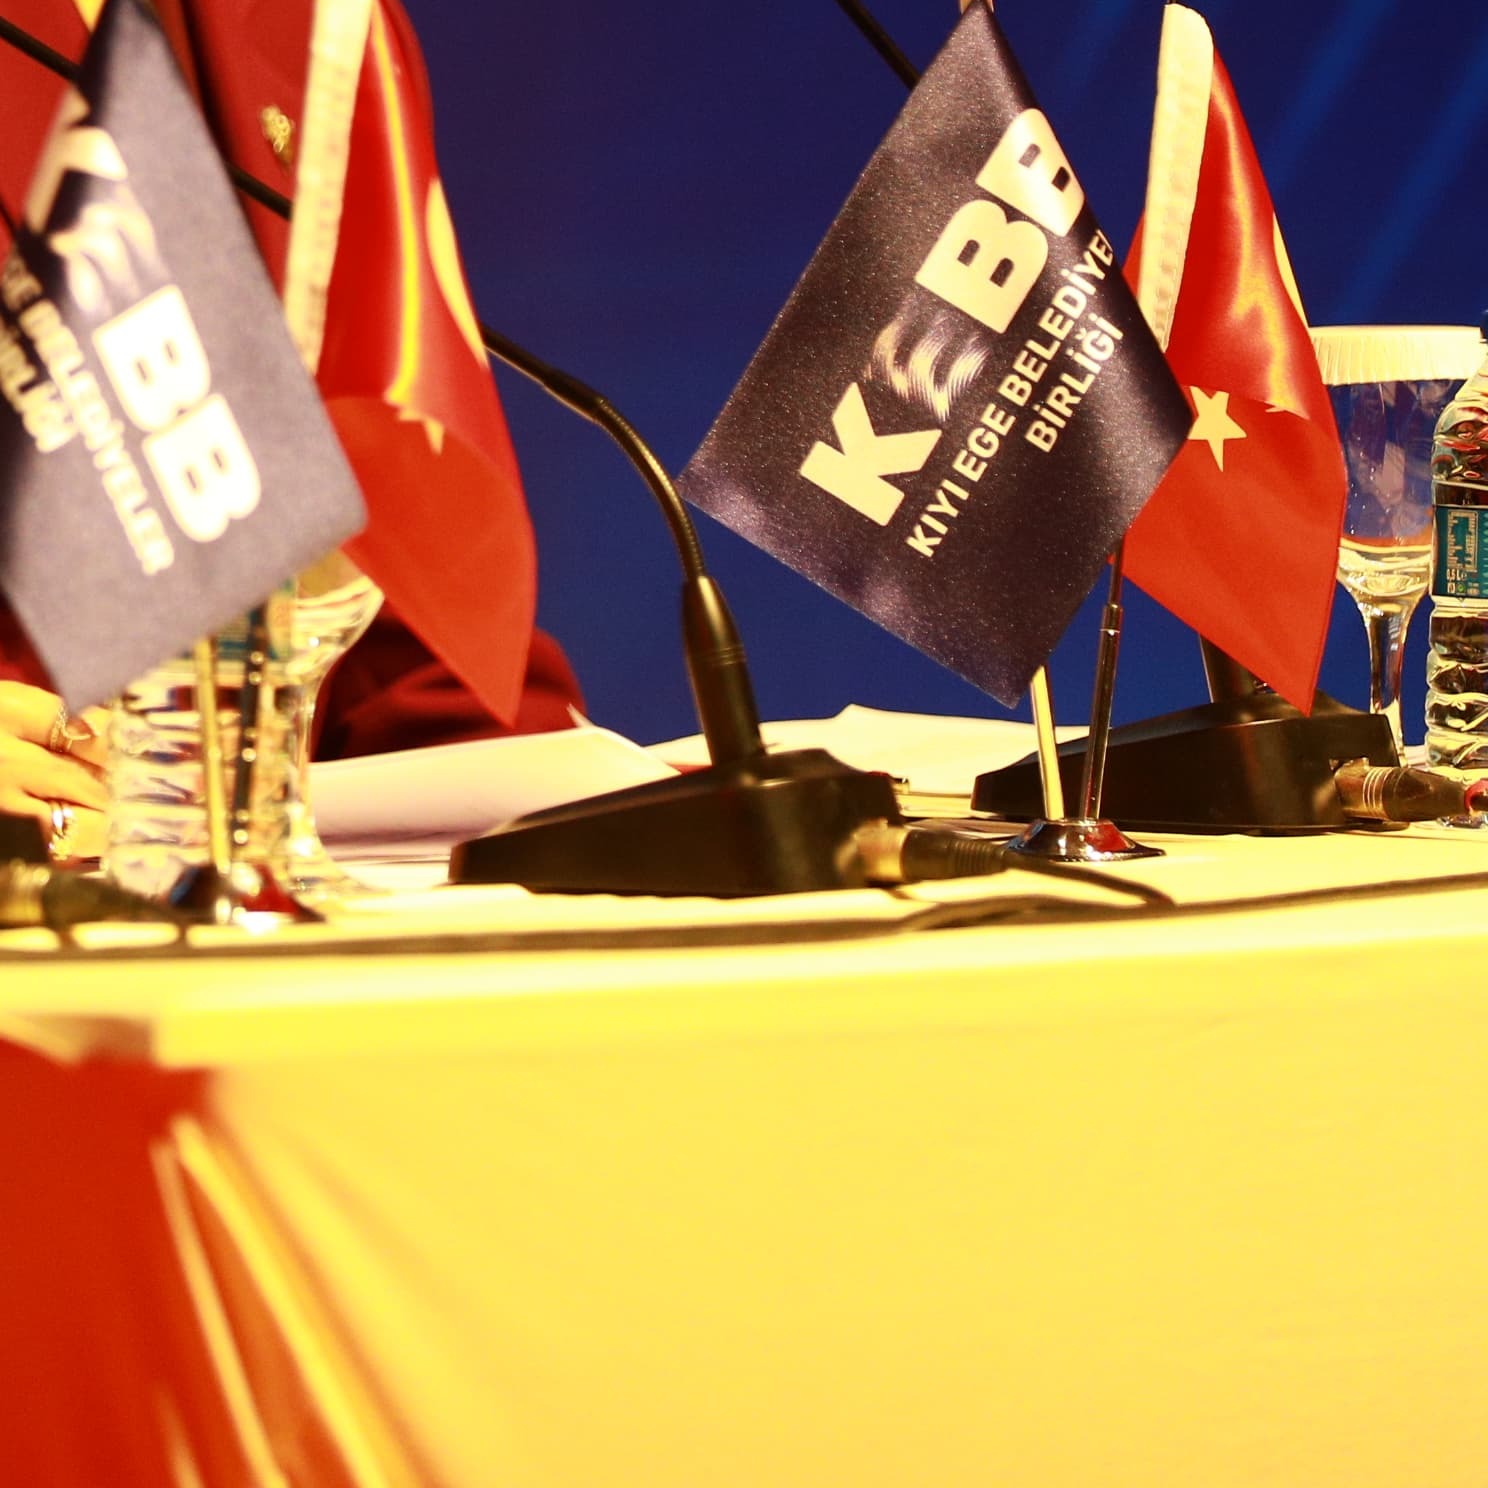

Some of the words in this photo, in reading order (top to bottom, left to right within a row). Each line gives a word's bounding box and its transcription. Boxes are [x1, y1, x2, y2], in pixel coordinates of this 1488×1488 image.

[905, 478, 970, 558] KIYI
[952, 402, 1017, 483] EGE
[997, 227, 1114, 407] BELEDİYE
[1024, 312, 1124, 454] BİRLİĞİ
